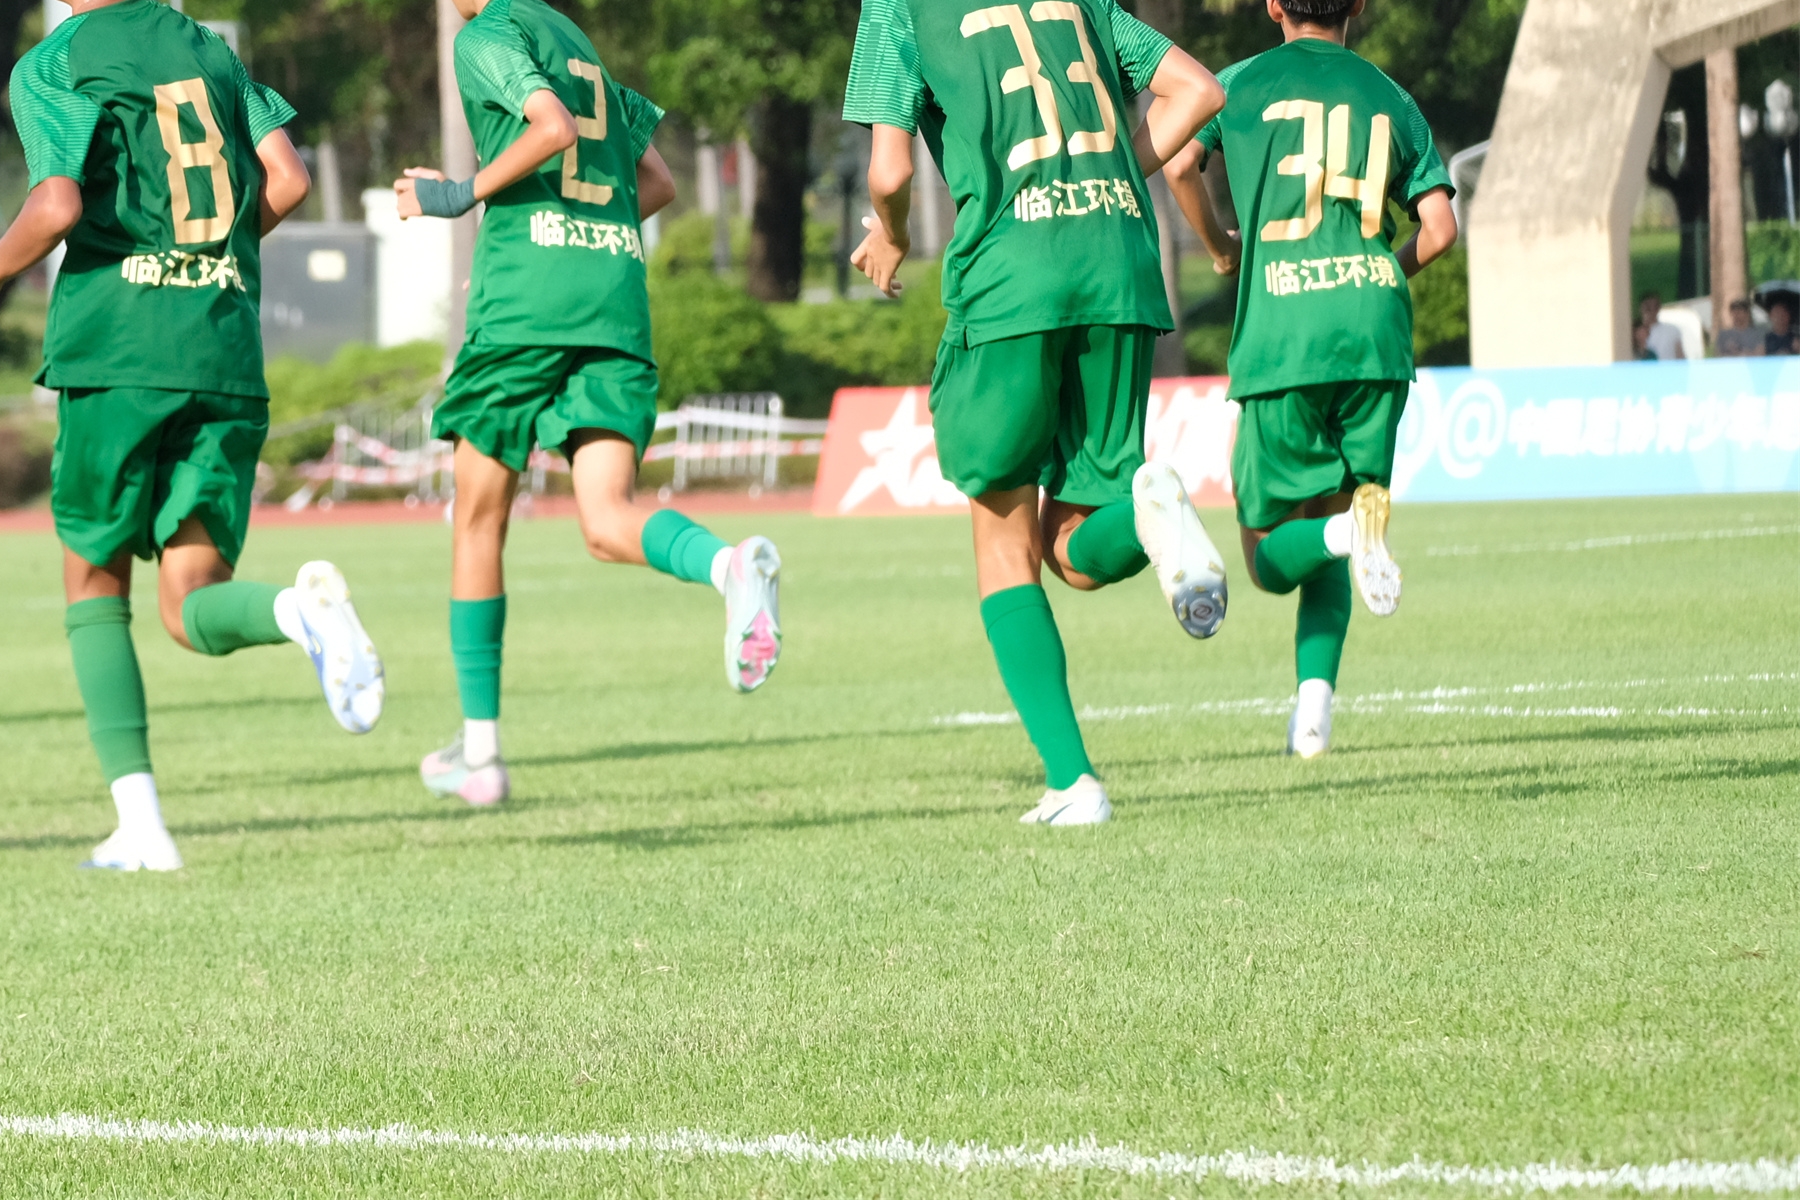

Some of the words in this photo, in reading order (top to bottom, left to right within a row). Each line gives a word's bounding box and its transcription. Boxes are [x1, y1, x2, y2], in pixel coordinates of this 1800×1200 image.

[561, 58, 614, 207] 2
[959, 0, 1117, 171] 33
[153, 77, 235, 245] 8
[1014, 178, 1142, 222] 临江环境
[1260, 99, 1390, 242] 34
[1265, 254, 1398, 297] 临江环境
